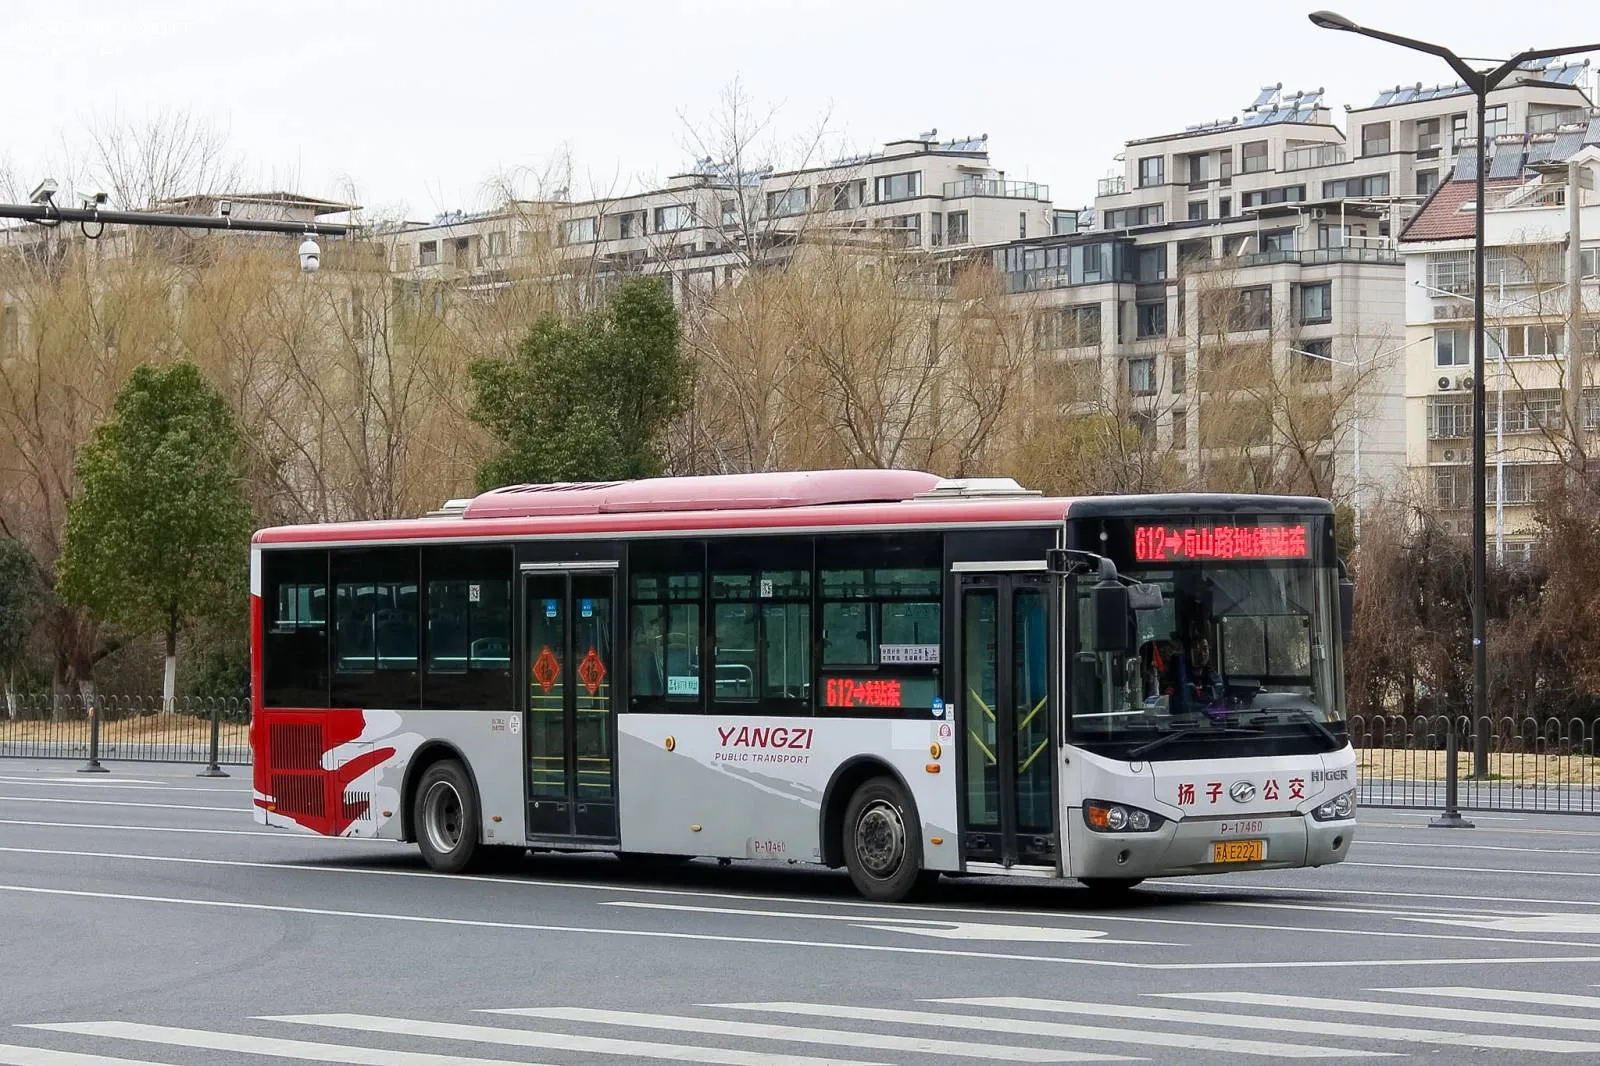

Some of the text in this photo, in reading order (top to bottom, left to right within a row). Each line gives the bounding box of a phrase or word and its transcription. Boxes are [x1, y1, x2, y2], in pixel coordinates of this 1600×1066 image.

[1136, 527, 1166, 561] 612
[826, 678, 854, 707] 612
[717, 726, 813, 750] YANGZI
[714, 752, 810, 764] PUBLIC TRANSPORT
[1311, 769, 1349, 782] HIGER
[1177, 777, 1305, 805] 扬子 公交
[1221, 820, 1263, 835] P-17460
